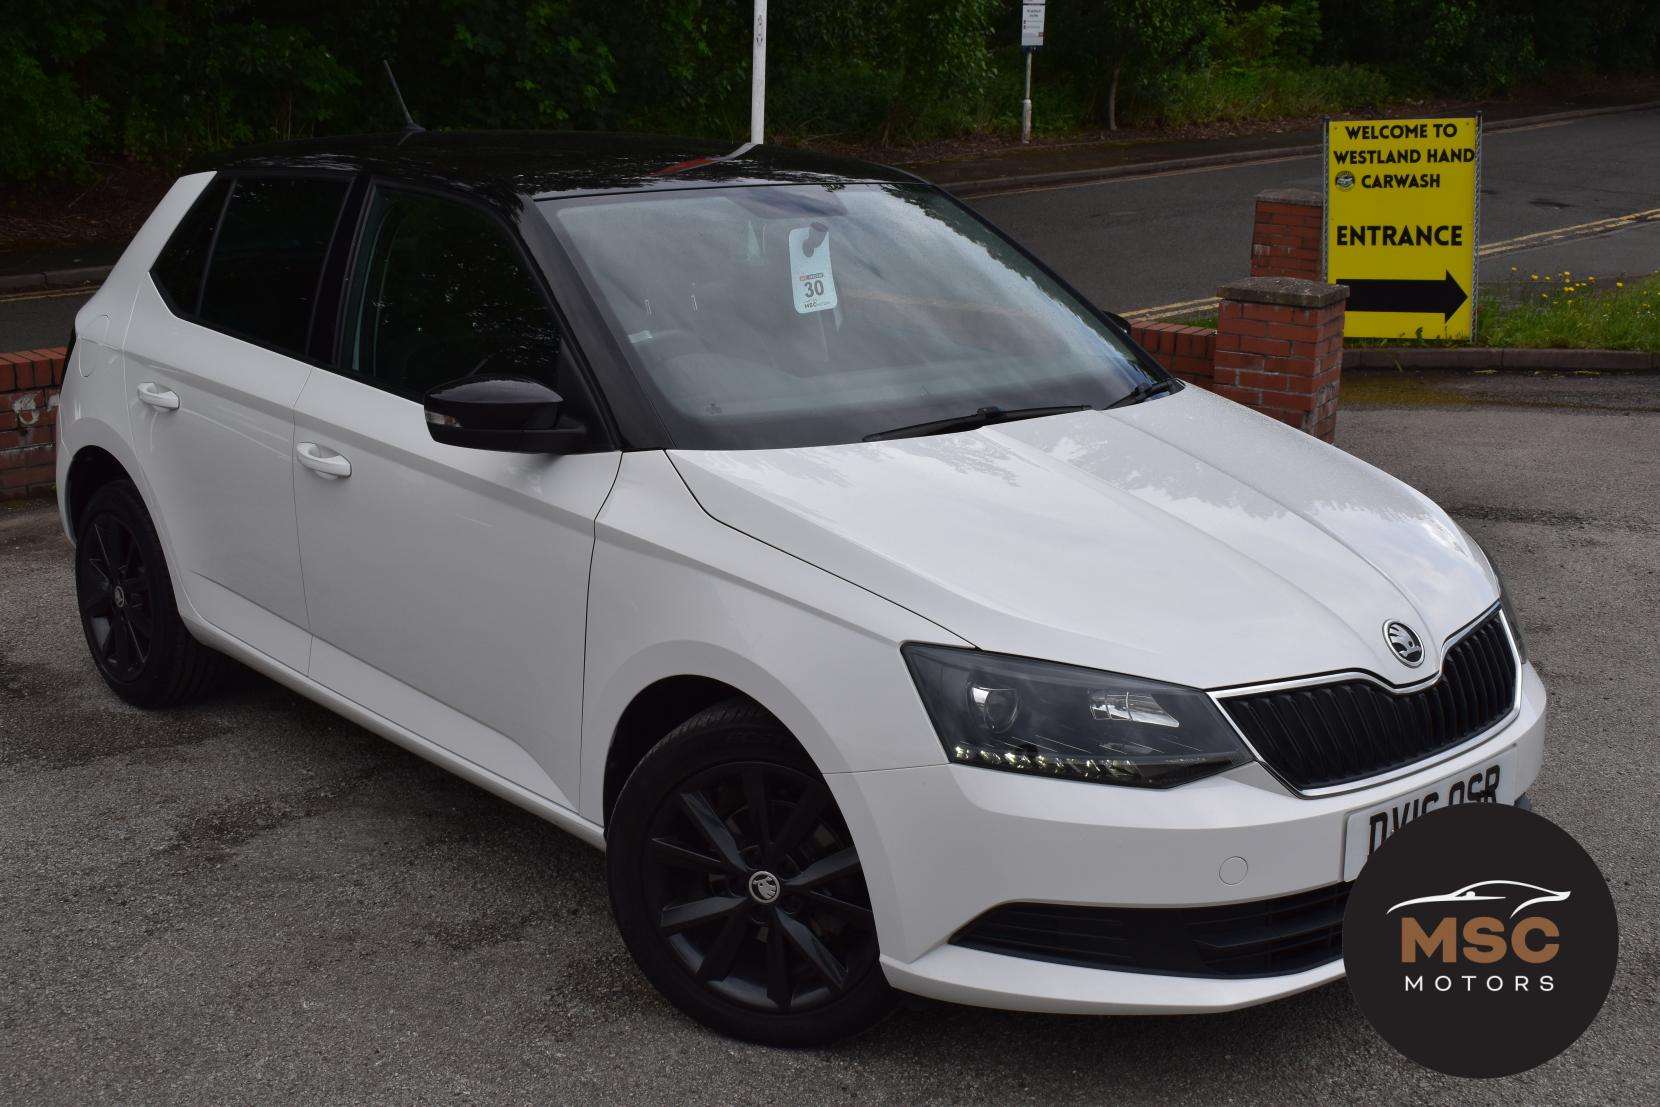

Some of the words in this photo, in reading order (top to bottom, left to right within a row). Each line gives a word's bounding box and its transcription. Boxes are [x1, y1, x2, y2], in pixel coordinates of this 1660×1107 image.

[1345, 124, 1428, 140] WELCOME
[1433, 123, 1457, 138] TO
[1333, 149, 1422, 164] WESTLAND
[1427, 148, 1475, 163] HAND
[1361, 173, 1441, 189] CARWASH
[1337, 225, 1463, 246] ENTRANCE
[804, 280, 824, 298] 30
